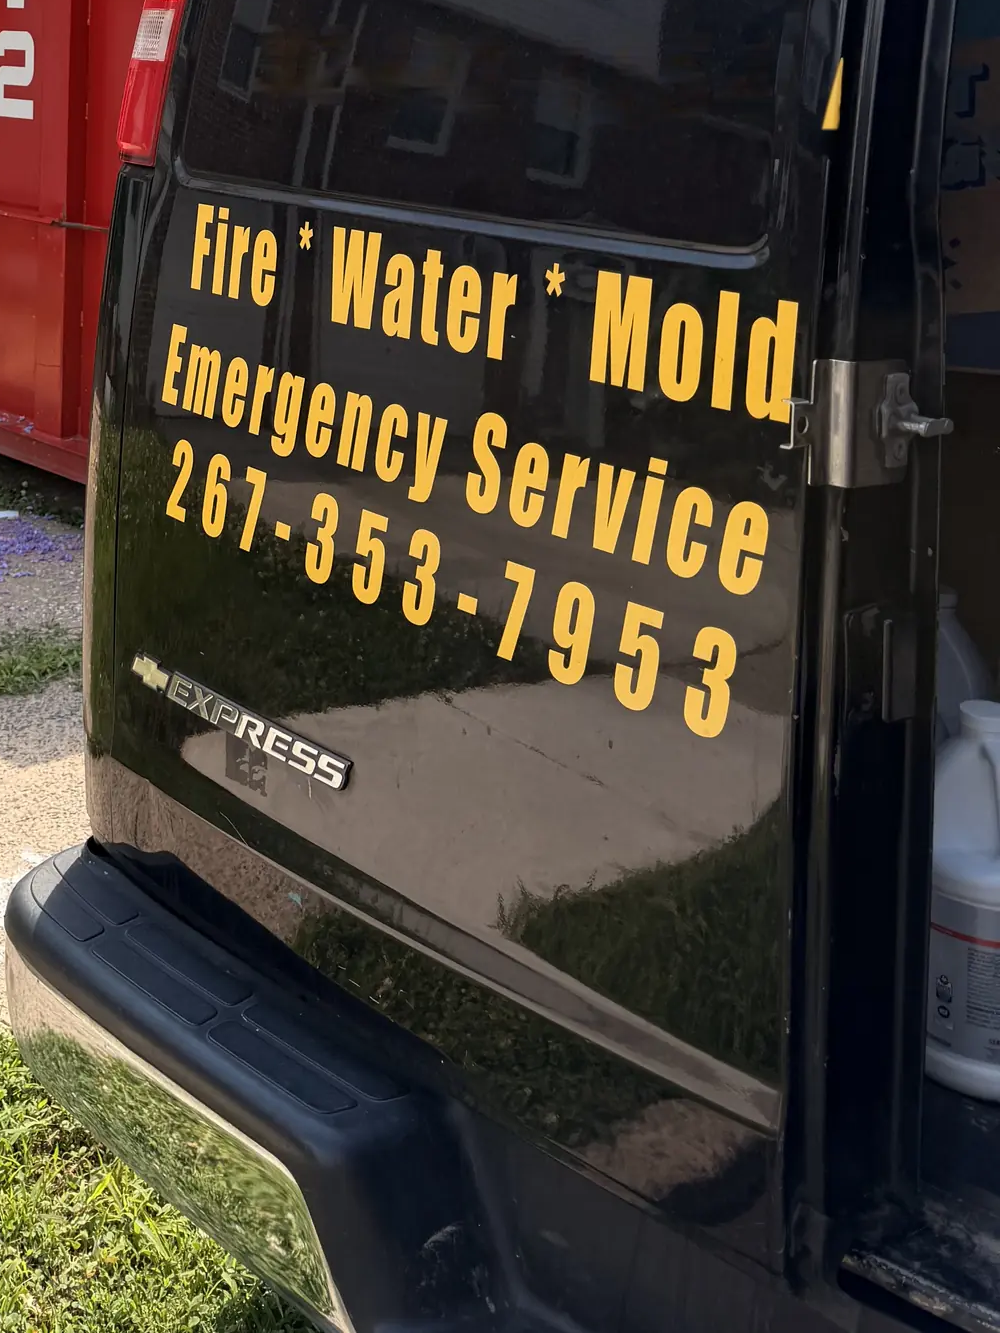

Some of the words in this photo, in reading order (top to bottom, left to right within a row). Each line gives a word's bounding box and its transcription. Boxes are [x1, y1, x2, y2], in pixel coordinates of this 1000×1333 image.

[190, 203, 278, 307] Fire
[330, 225, 518, 361] Water
[588, 270, 799, 424] Mold
[161, 323, 448, 503] Emergency
[465, 411, 769, 596] Service
[165, 438, 738, 738] 267-353-7953
[167, 673, 347, 789] EXPRESS
